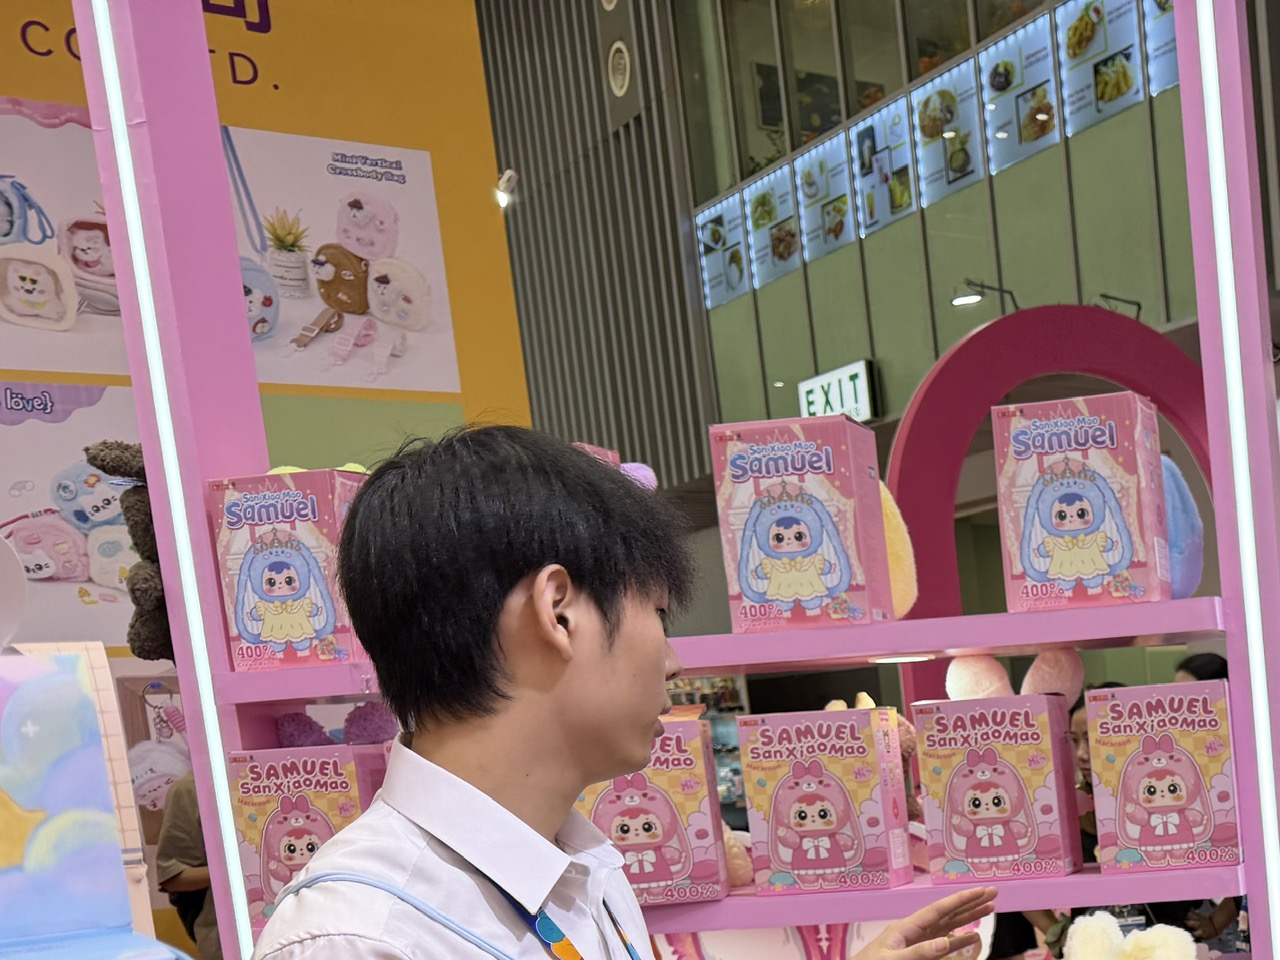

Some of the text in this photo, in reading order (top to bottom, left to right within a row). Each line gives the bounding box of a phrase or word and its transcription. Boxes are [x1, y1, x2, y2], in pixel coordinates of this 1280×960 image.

[804, 372, 860, 418] EXIT
[1011, 421, 1117, 459] Samuel
[730, 447, 833, 482] Samuel
[224, 496, 318, 529] Samuel
[1021, 583, 1065, 598] 400%
[740, 604, 784, 619] 400%
[237, 644, 277, 659] 400%
[1109, 696, 1215, 722] SAMUEL
[935, 709, 1036, 734] SAMUEL
[1099, 716, 1219, 734] SanXiaoMao
[760, 722, 862, 746] SAMUEL
[926, 729, 1041, 747] SanXiaoMao
[750, 743, 867, 759] SanXiaoMao
[249, 759, 344, 782] SAMUEL
[240, 778, 350, 795] SanXiaoMao
[1185, 848, 1235, 862] 400%
[1011, 860, 1061, 876] 400%
[838, 871, 888, 887] 400%
[663, 884, 719, 900] 400%
